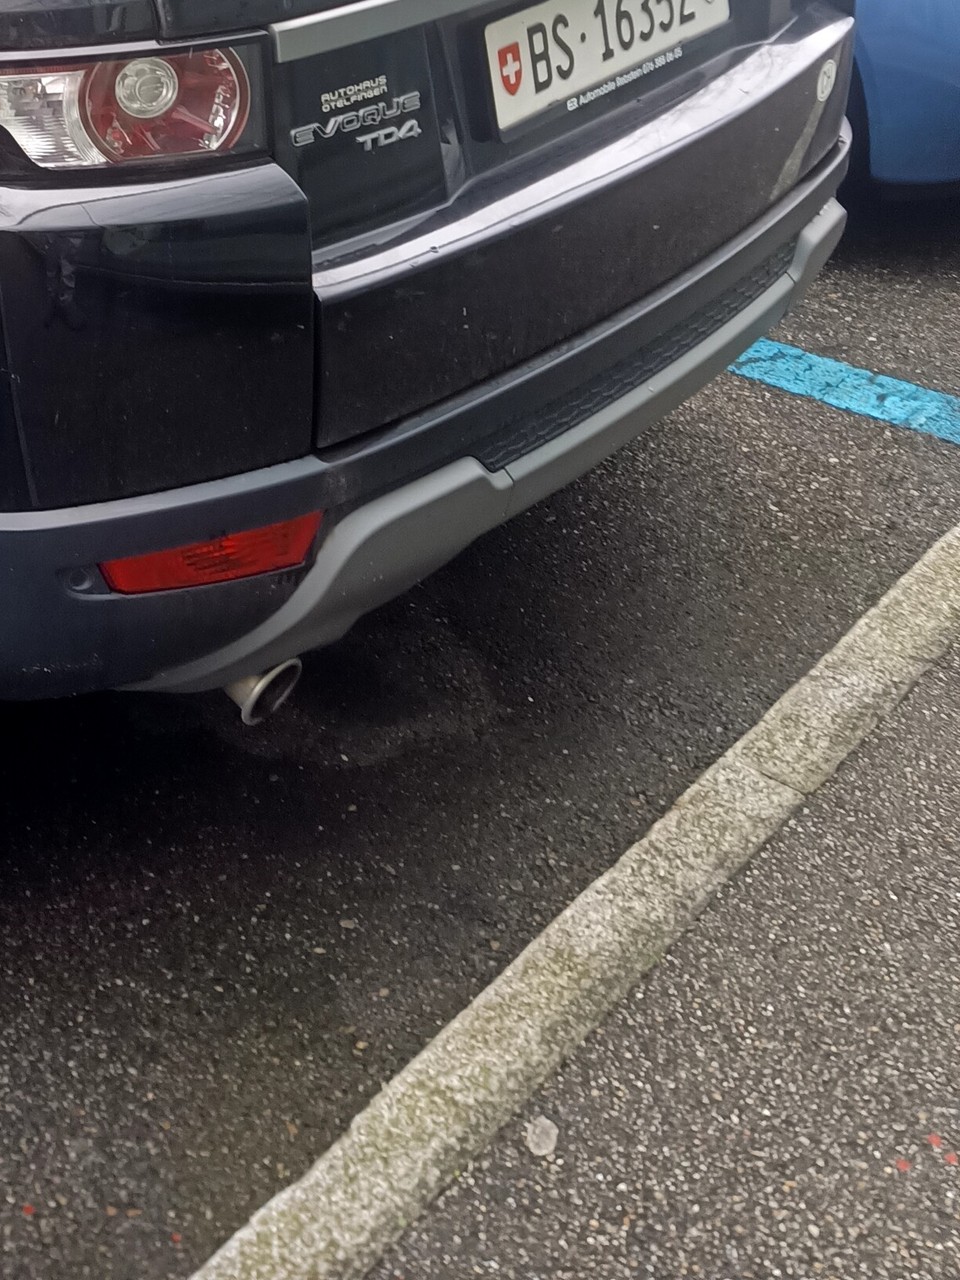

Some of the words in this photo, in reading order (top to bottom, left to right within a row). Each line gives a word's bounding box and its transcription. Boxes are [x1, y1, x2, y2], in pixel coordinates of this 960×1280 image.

[321, 75, 387, 104] AUTOHAUS
[578, 81, 616, 105] Automobile
[290, 91, 421, 147] EVOQUE
[355, 119, 422, 151] TD4
